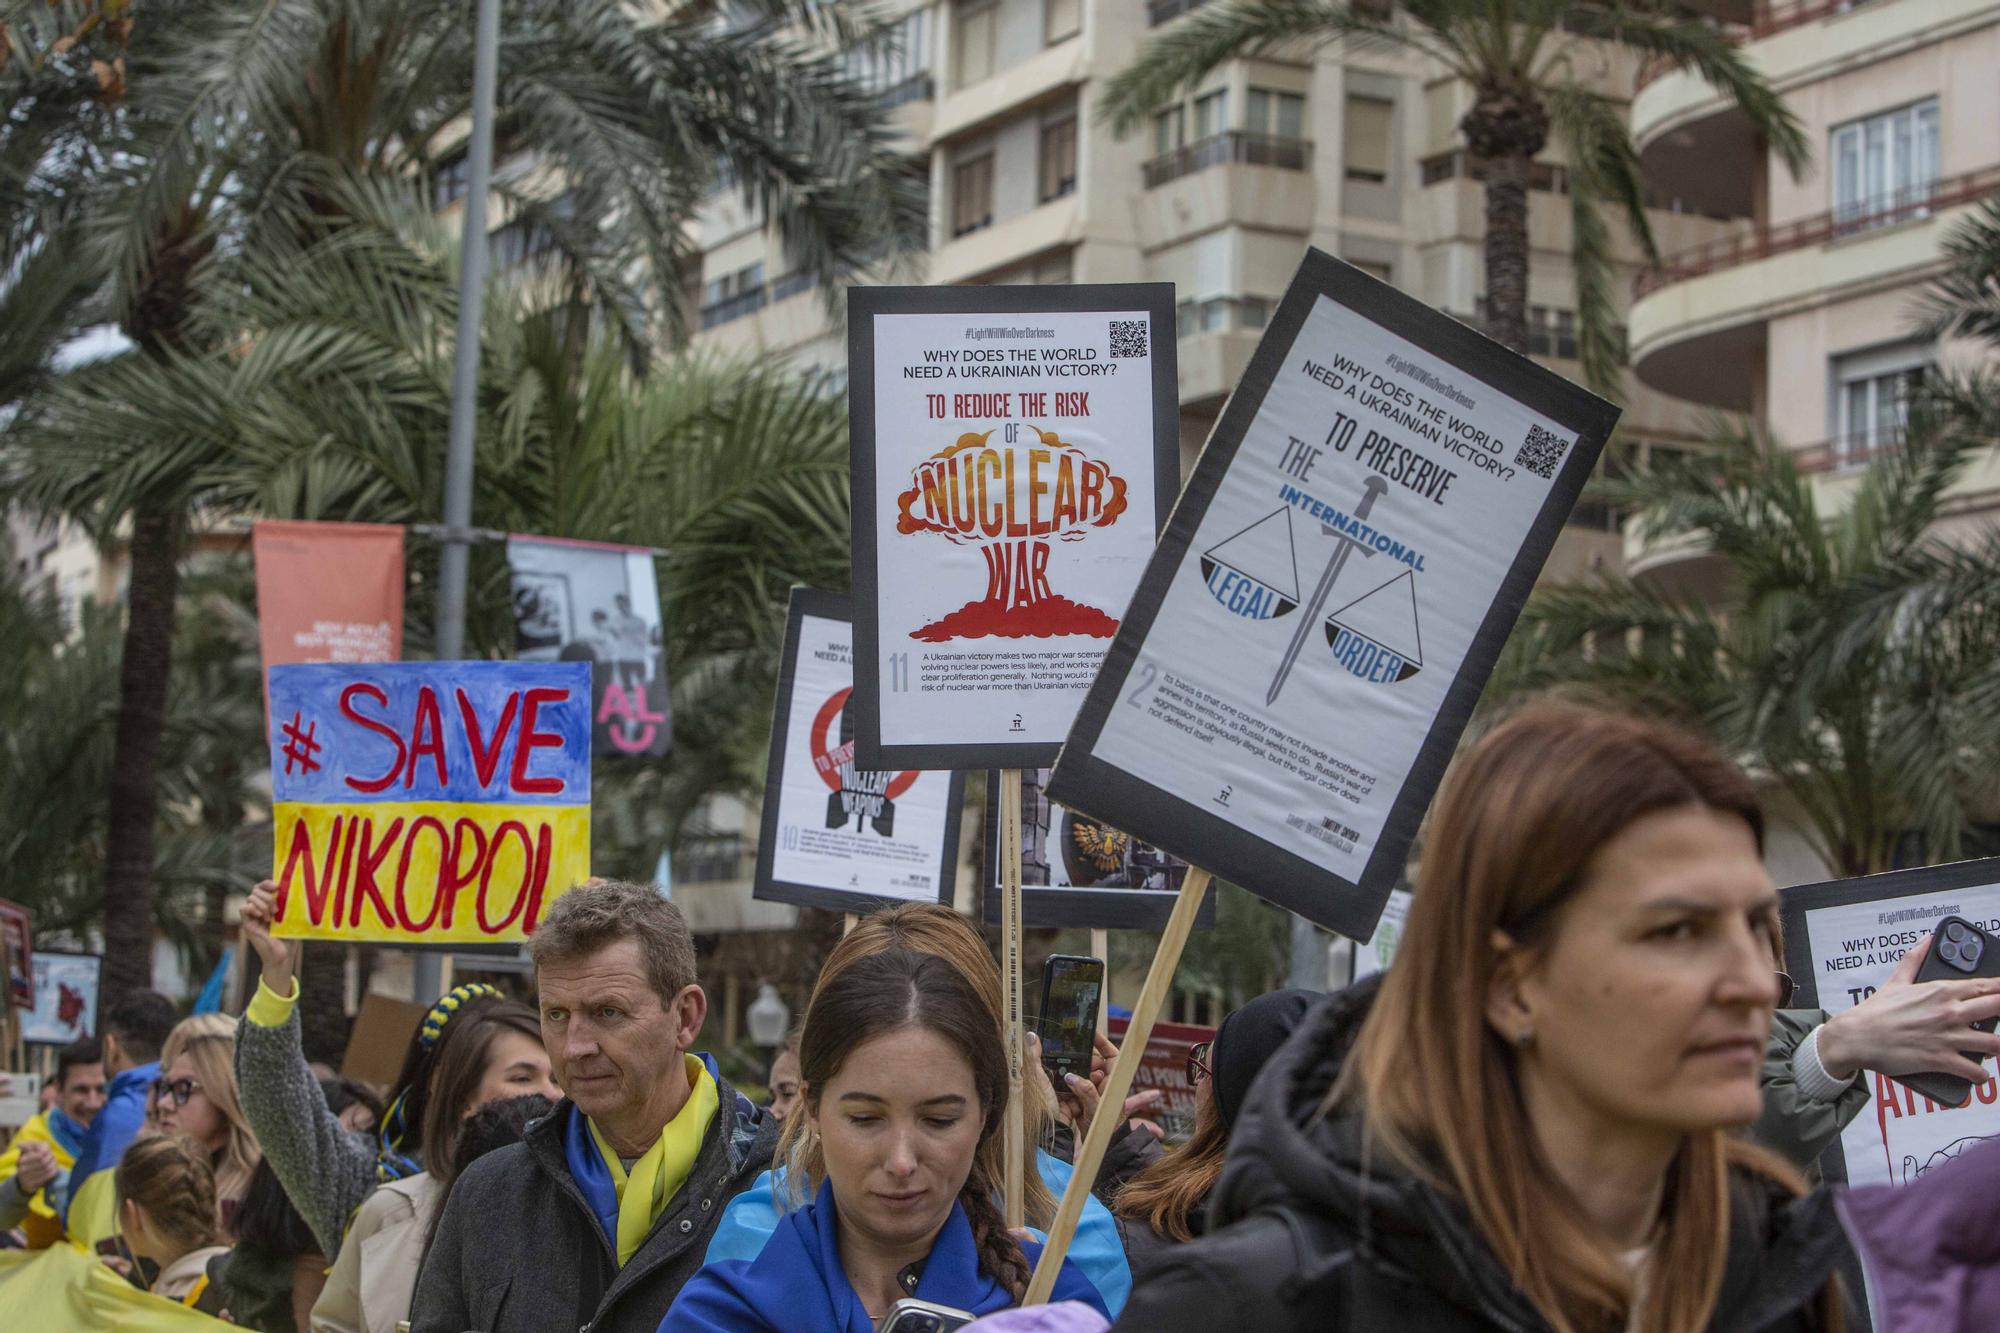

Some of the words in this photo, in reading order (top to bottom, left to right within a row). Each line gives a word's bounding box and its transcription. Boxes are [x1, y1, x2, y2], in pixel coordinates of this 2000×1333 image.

[964, 326, 1056, 342] #LightWillWinOverDarkness
[923, 350, 960, 363] WHY
[962, 349, 1005, 363] DOES
[1007, 348, 1038, 362] THE
[1040, 348, 1097, 362] WORLD
[903, 366, 943, 379] NEED
[946, 365, 958, 379] A
[960, 364, 1041, 379] UKRAINIAN
[1044, 363, 1118, 377] VICTORY?
[926, 394, 946, 419] TO
[954, 393, 1012, 418] REDUCE
[1019, 392, 1048, 417] THE
[1055, 392, 1091, 417] RISK
[1333, 353, 1373, 383] WHY
[1369, 374, 1415, 408] DOES
[1416, 397, 1448, 425] THE
[1447, 415, 1504, 455] WORLD
[1005, 423, 1020, 444] OF
[1301, 359, 1345, 391] NEED
[1343, 384, 1357, 400] A
[1359, 389, 1442, 444] UKRAINIAN
[1443, 434, 1516, 483] VICTORY?
[1277, 435, 1323, 484] THE
[1325, 411, 1357, 453] TO
[1355, 429, 1457, 506] PRESERVE
[921, 447, 1105, 538] NUCLEAR
[1278, 483, 1425, 573] INTERNATIONAL
[981, 541, 1053, 613] WAR
[1208, 565, 1275, 621] LEGAL
[814, 651, 838, 663] NEED
[920, 663, 950, 673] volving
[950, 662, 980, 672] nuclear
[980, 663, 1010, 673] powers
[1010, 662, 1027, 671] less
[1026, 661, 1049, 671] likely,
[1049, 660, 1066, 670] and
[1065, 660, 1090, 669] works
[922, 653, 930, 662] A
[930, 652, 967, 662] Ukrainian
[966, 652, 995, 662] victory
[994, 651, 1021, 661] makes
[1021, 652, 1038, 660] two
[1038, 651, 1061, 661] major
[1332, 630, 1402, 684] ORDER
[889, 652, 909, 693] 11
[920, 673, 941, 682] clear
[941, 672, 990, 684] proliferation
[989, 671, 1028, 683] generally.
[1030, 671, 1063, 681] Nothing
[1063, 670, 1089, 680] would
[921, 683, 936, 692] risk
[935, 682, 946, 692] of
[946, 683, 976, 692] nuclear
[991, 682, 1019, 691] more
[1018, 682, 1033, 691] than
[1033, 681, 1070, 691] Ukrainian
[1127, 663, 1156, 710] 2
[1877, 904, 1961, 926] #LightWillWinOverDarkness
[1842, 936, 1877, 953] WHY
[1878, 930, 1918, 948] DOES
[1825, 954, 1864, 972] NEED
[1866, 953, 1878, 967] A
